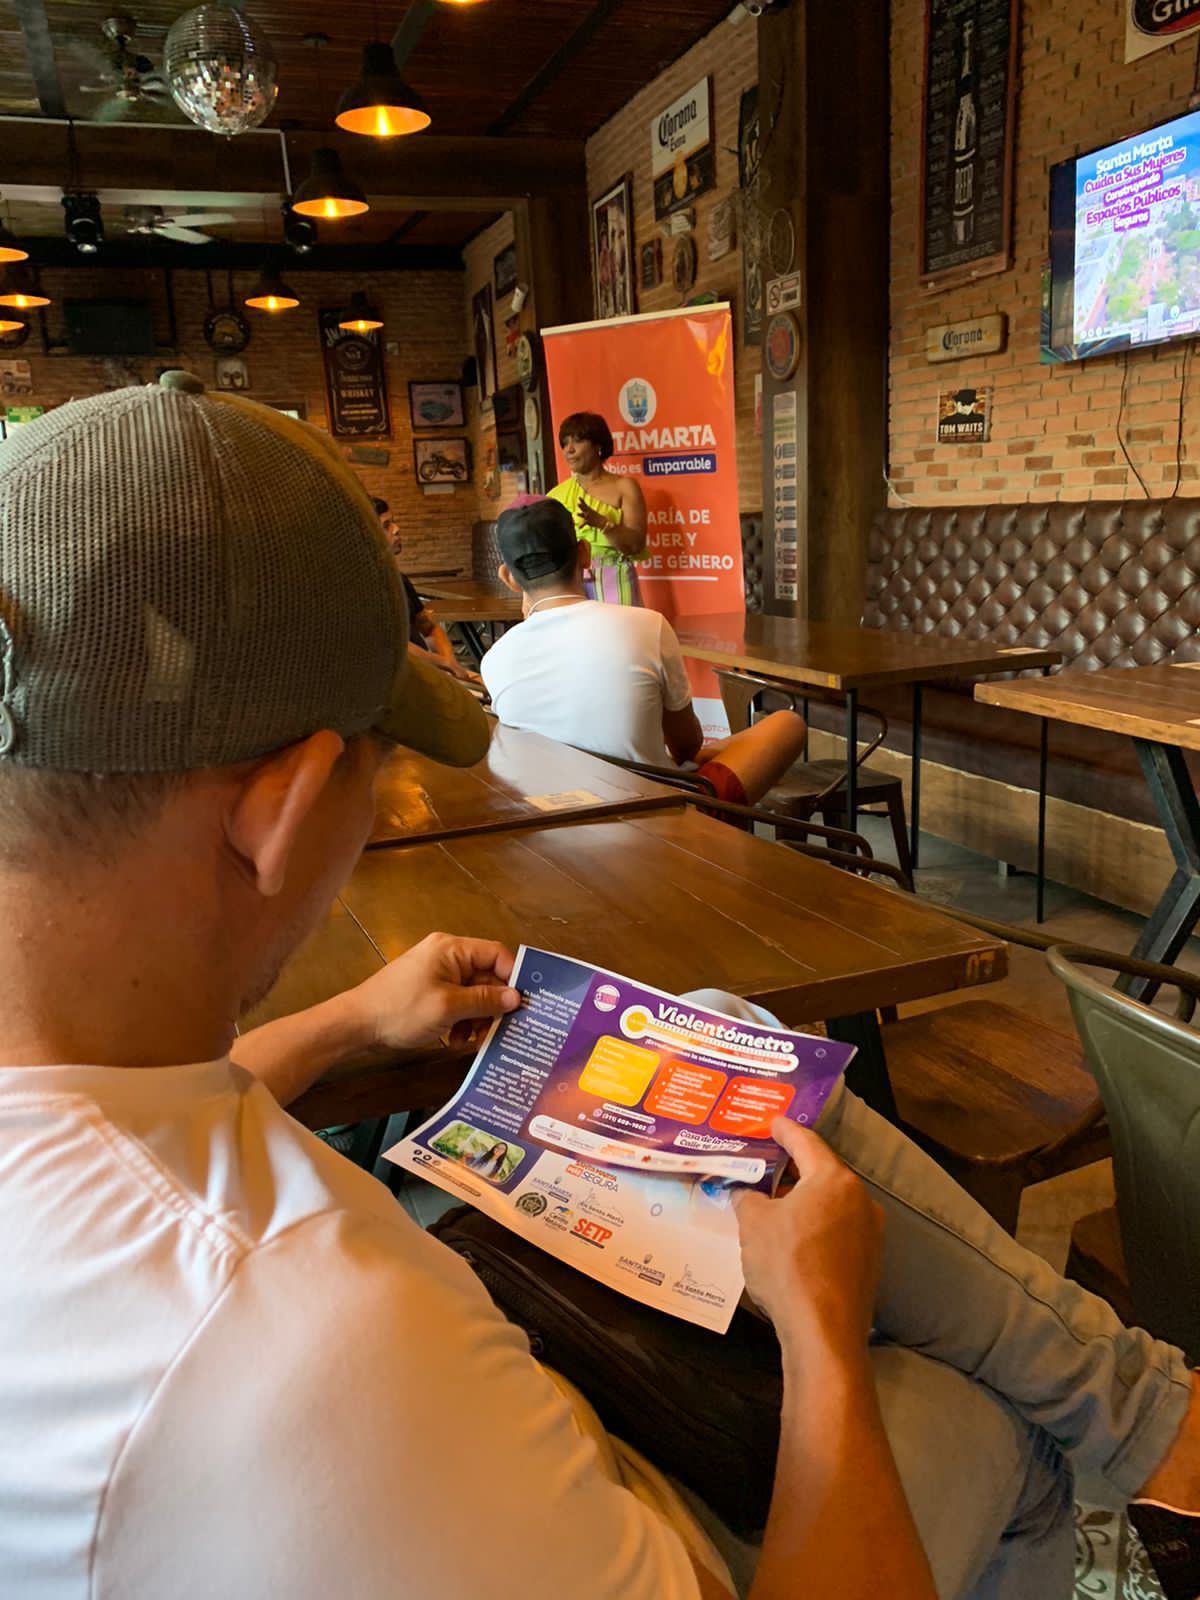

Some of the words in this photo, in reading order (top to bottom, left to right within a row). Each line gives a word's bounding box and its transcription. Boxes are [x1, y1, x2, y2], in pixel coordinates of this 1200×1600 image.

[658, 99, 697, 147] Corona
[1096, 151, 1132, 174] Santa
[1133, 135, 1174, 160] Marta
[1084, 174, 1114, 193] Cuida
[1123, 165, 1142, 180] Sus
[1142, 148, 1186, 173] Mujeres
[1086, 201, 1132, 225] Espacios
[1133, 184, 1181, 209] Públicos
[942, 328, 983, 350] Corona
[612, 423, 717, 452] TAMARTA
[940, 424, 956, 434] TOM
[957, 422, 983, 433] WAITS
[629, 463, 641, 474] es
[648, 459, 712, 475] imparable
[689, 509, 711, 525] DE
[646, 532, 683, 547] JER
[686, 532, 698, 547] Y
[641, 555, 663, 569] DE
[667, 551, 734, 571] GÉNERO
[658, 1003, 795, 1054] Violentómetro
[581, 1170, 619, 1192] SEGURA
[573, 1217, 613, 1245] SETP
